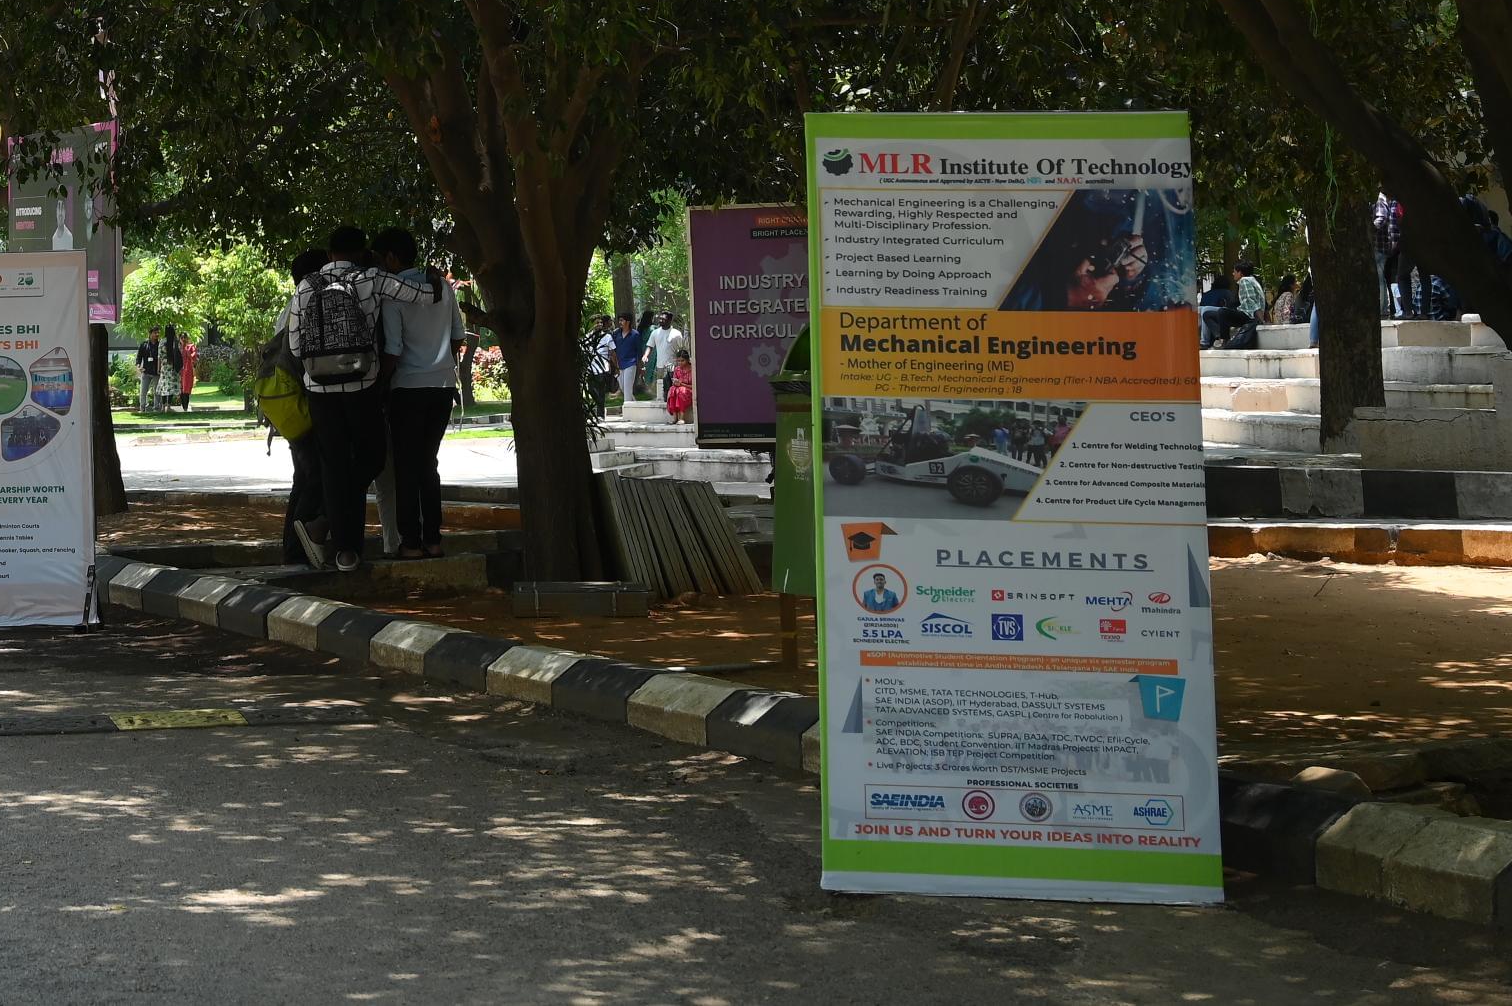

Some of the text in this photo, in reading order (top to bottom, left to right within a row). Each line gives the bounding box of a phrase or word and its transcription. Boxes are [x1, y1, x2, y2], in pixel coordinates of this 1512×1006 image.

[859, 153, 1192, 178] MLR Institute Of Technology
[834, 198, 894, 207] Mechanical
[899, 199, 964, 208] Engineering
[969, 199, 976, 207] is
[989, 199, 1058, 209] Challenging,
[834, 209, 895, 219] Rewarding,
[899, 210, 933, 219] Highly
[937, 210, 993, 221] Respected
[834, 221, 991, 231] Multi-Disciplinary Profession.
[835, 236, 1003, 246] Industry Integrated Curriculum
[836, 254, 961, 264] Project Based Learning
[836, 269, 991, 279] Learning by Doing Approach
[719, 274, 804, 290] INDUSTRY
[837, 286, 987, 297] Industry Readiness Training
[840, 312, 987, 333] Department of
[17, 325, 39, 334] BHI
[15, 341, 39, 350] BHI
[841, 335, 1136, 359] Mechanical Engineering
[848, 359, 1014, 372] Mother of Engineering (ME)
[1130, 412, 1175, 422] CEO'S
[1125, 443, 1157, 451] Welding
[931, 463, 943, 473] 92
[26, 496, 48, 504] YEAR
[937, 549, 1148, 569] PLACEMENTS
[916, 586, 976, 596] Schneider
[1086, 596, 1132, 606] MEHTA
[922, 624, 972, 634] SISCOL
[1141, 630, 1180, 638] CYIENT
[863, 630, 902, 639] 5.5 LPA
[967, 779, 1032, 788] PROFESSIONAL
[871, 793, 945, 808] SAEINDIA
[1073, 804, 1112, 816] ASME
[1134, 807, 1167, 817] ASHRAE
[855, 824, 1201, 847] JOIN US AND TURN YOUR IDEAS INTO REALITY
